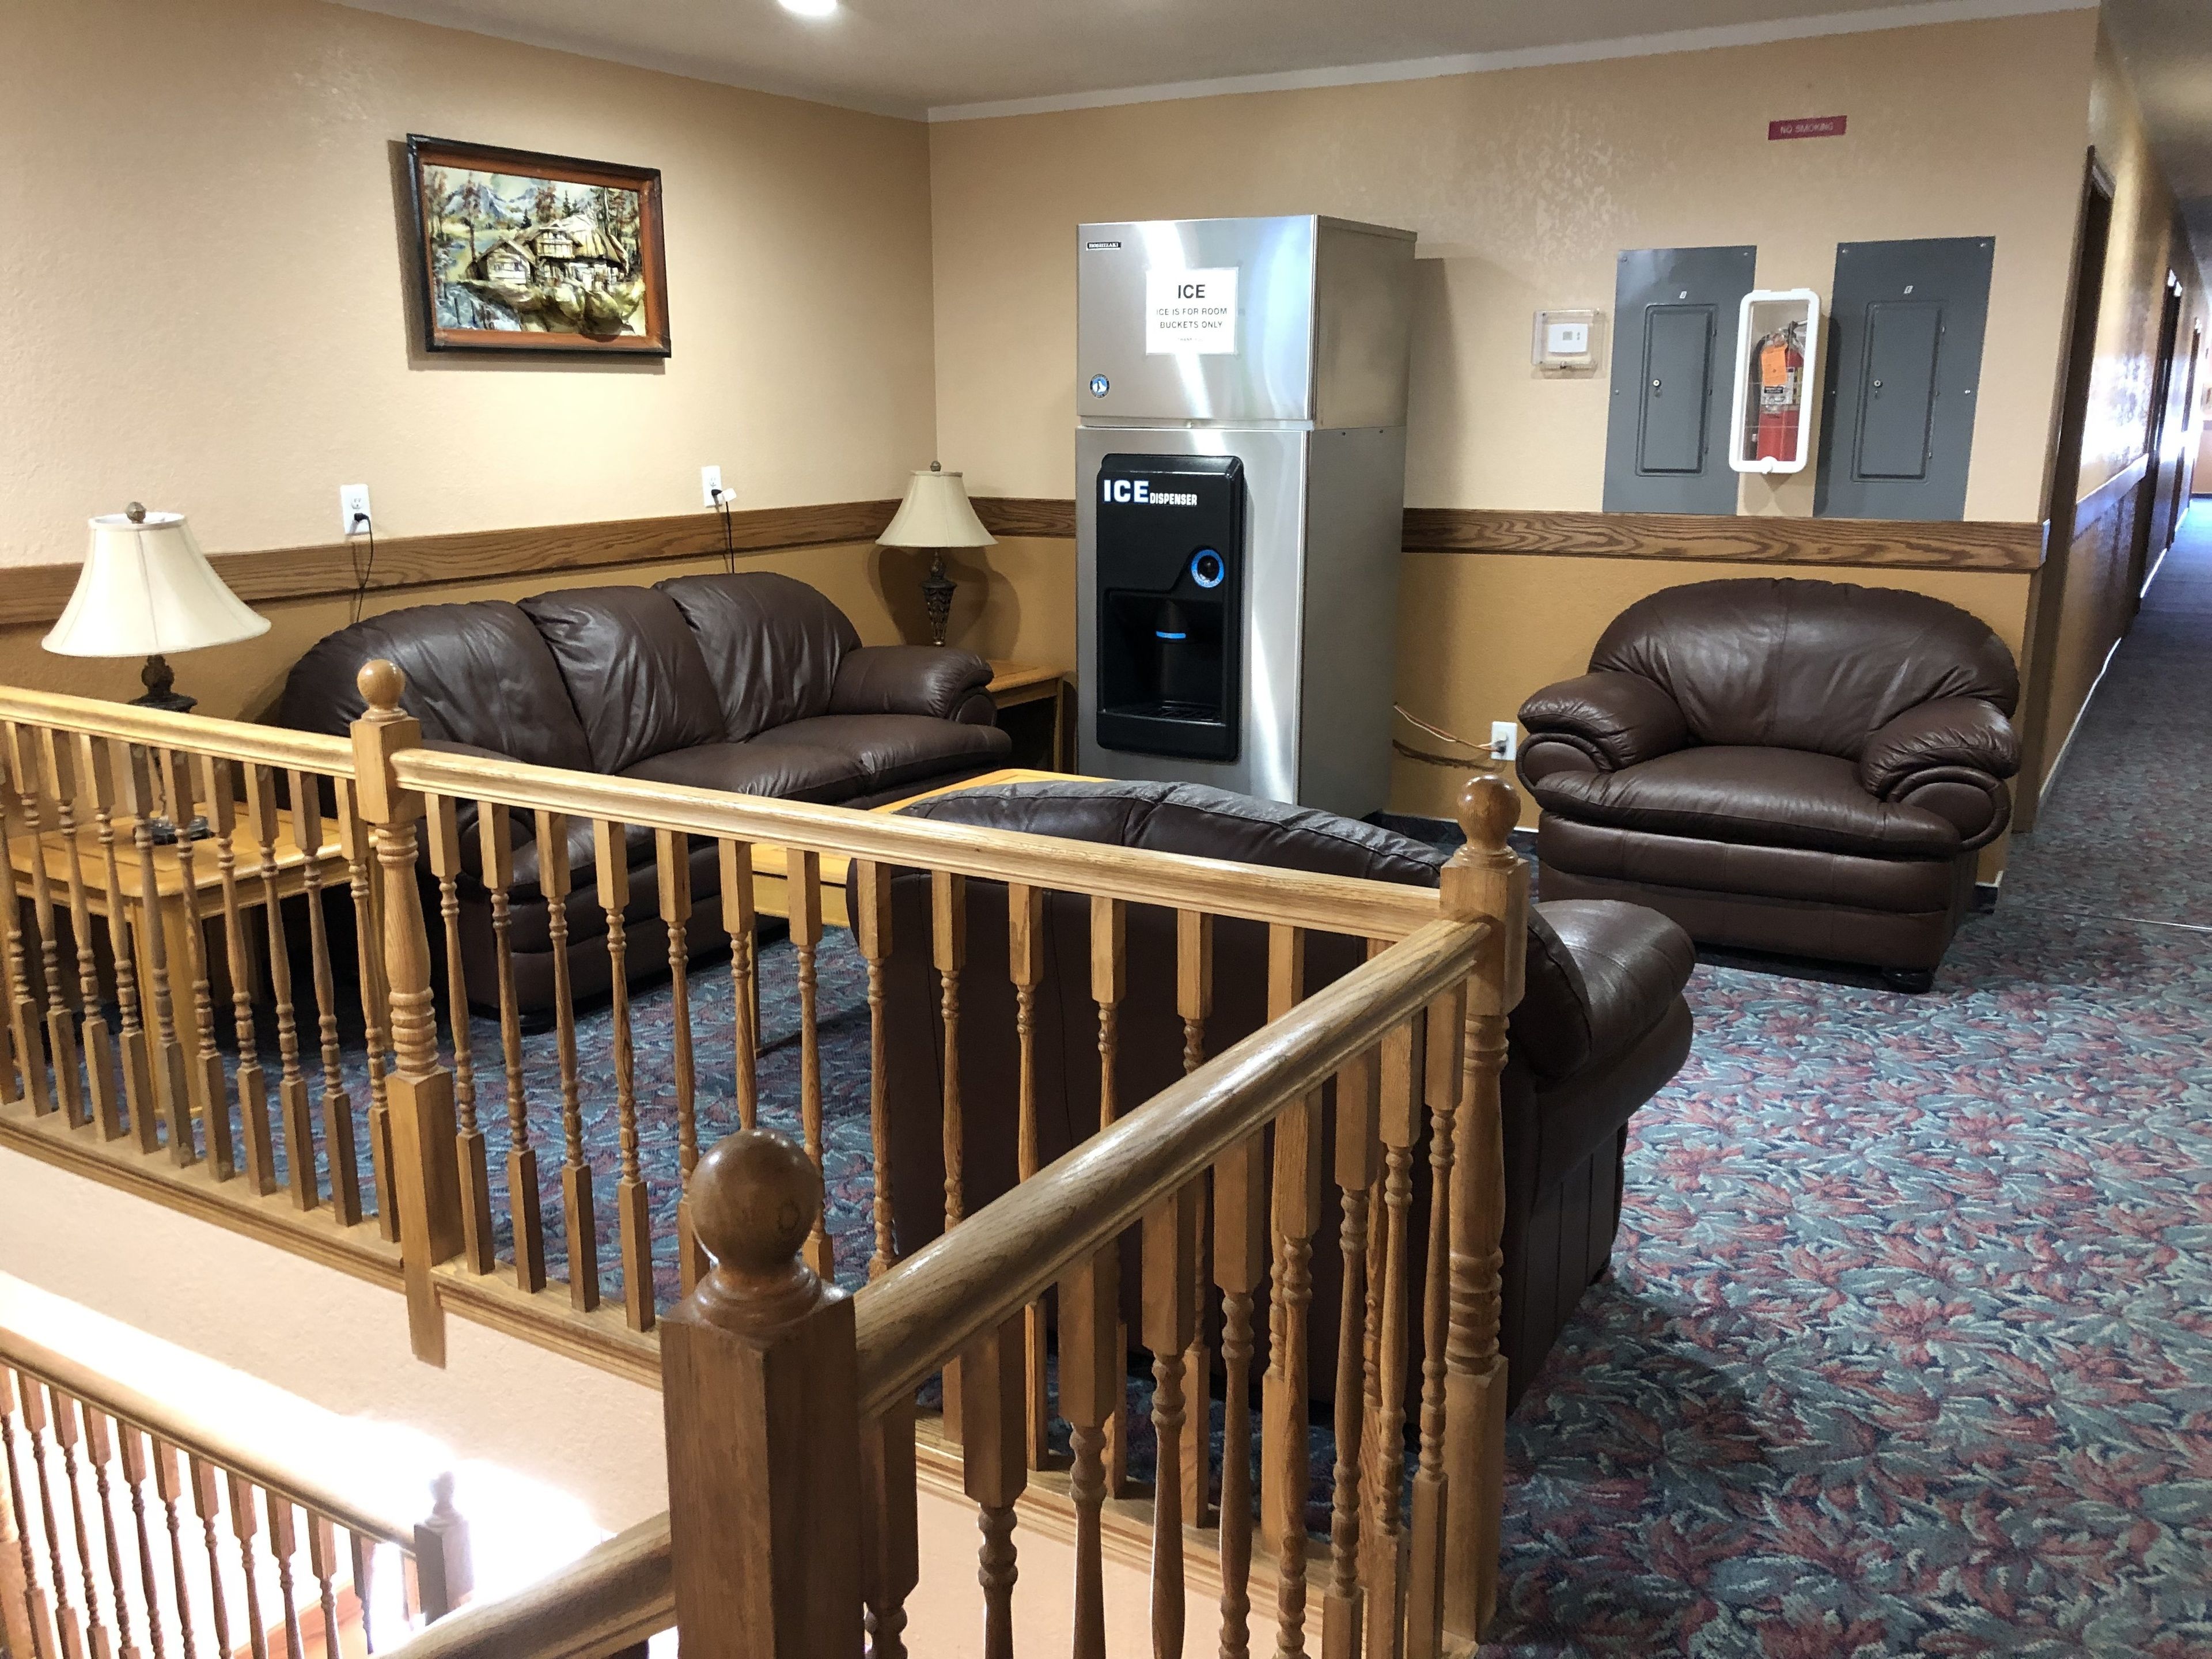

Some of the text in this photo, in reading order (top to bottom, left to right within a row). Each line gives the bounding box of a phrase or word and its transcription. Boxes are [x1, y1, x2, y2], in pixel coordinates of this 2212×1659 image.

[1780, 122, 1834, 134] NO SMOKING
[1177, 284, 1206, 298] ICE
[1103, 479, 1198, 506] ICE DISPENSER
